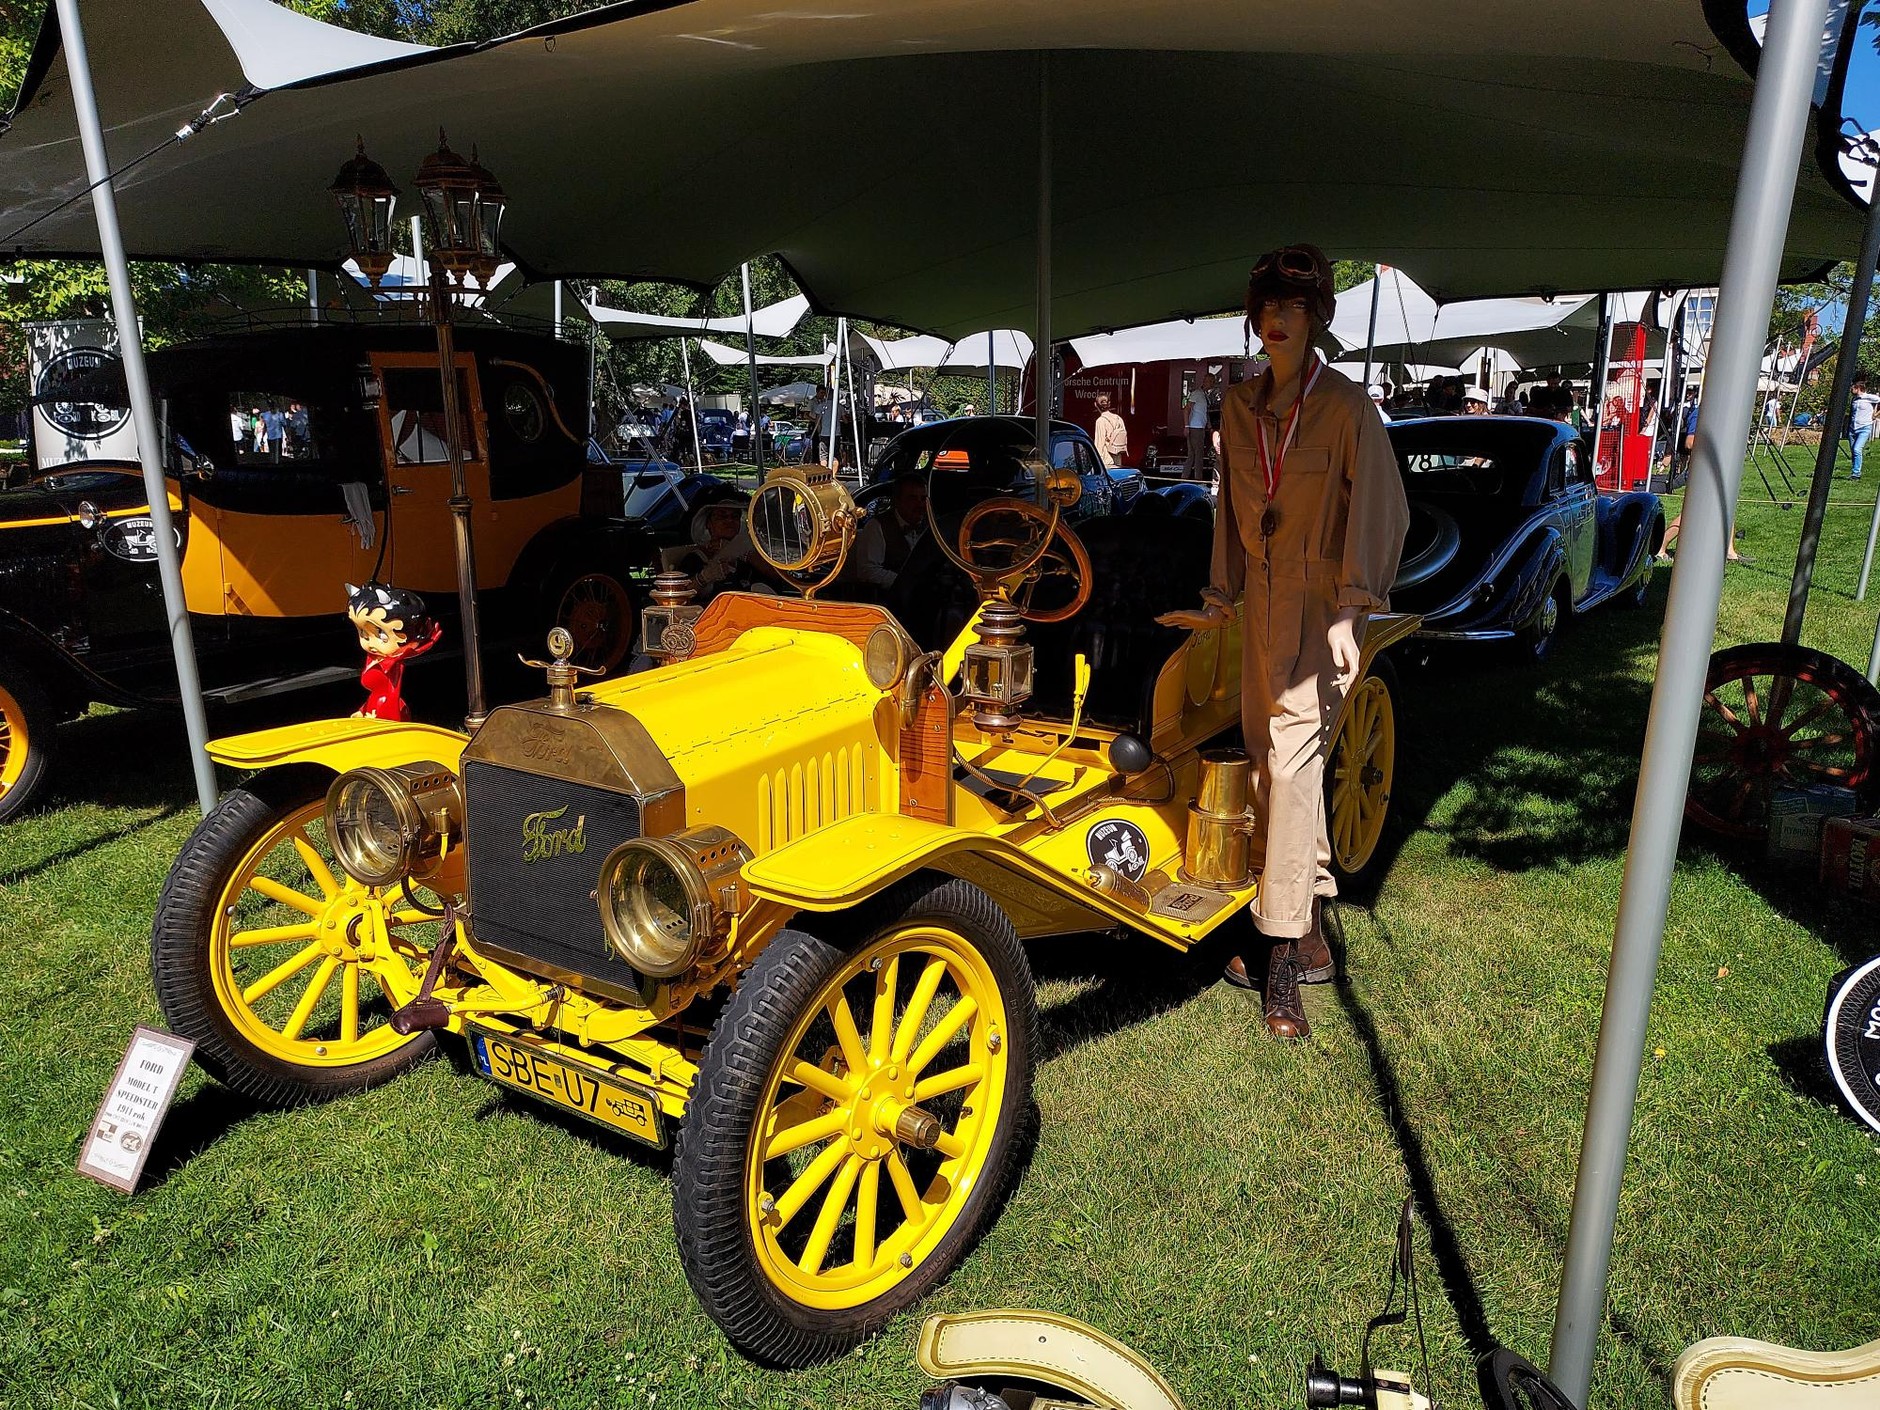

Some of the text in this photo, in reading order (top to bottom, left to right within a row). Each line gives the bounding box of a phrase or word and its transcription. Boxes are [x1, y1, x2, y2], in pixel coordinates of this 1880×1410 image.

[1064, 375, 1129, 387] orsche Centrum
[520, 721, 571, 766] Ford
[521, 804, 587, 865] Ford
[1094, 823, 1119, 841] MUZEUM
[139, 1060, 164, 1075] FORD
[491, 1041, 600, 1113] SBE U7
[128, 1077, 159, 1095] MODEL T
[116, 1089, 159, 1110] SPEEDSTER
[116, 1103, 132, 1117] 1911
[132, 1108, 146, 1122] rok
